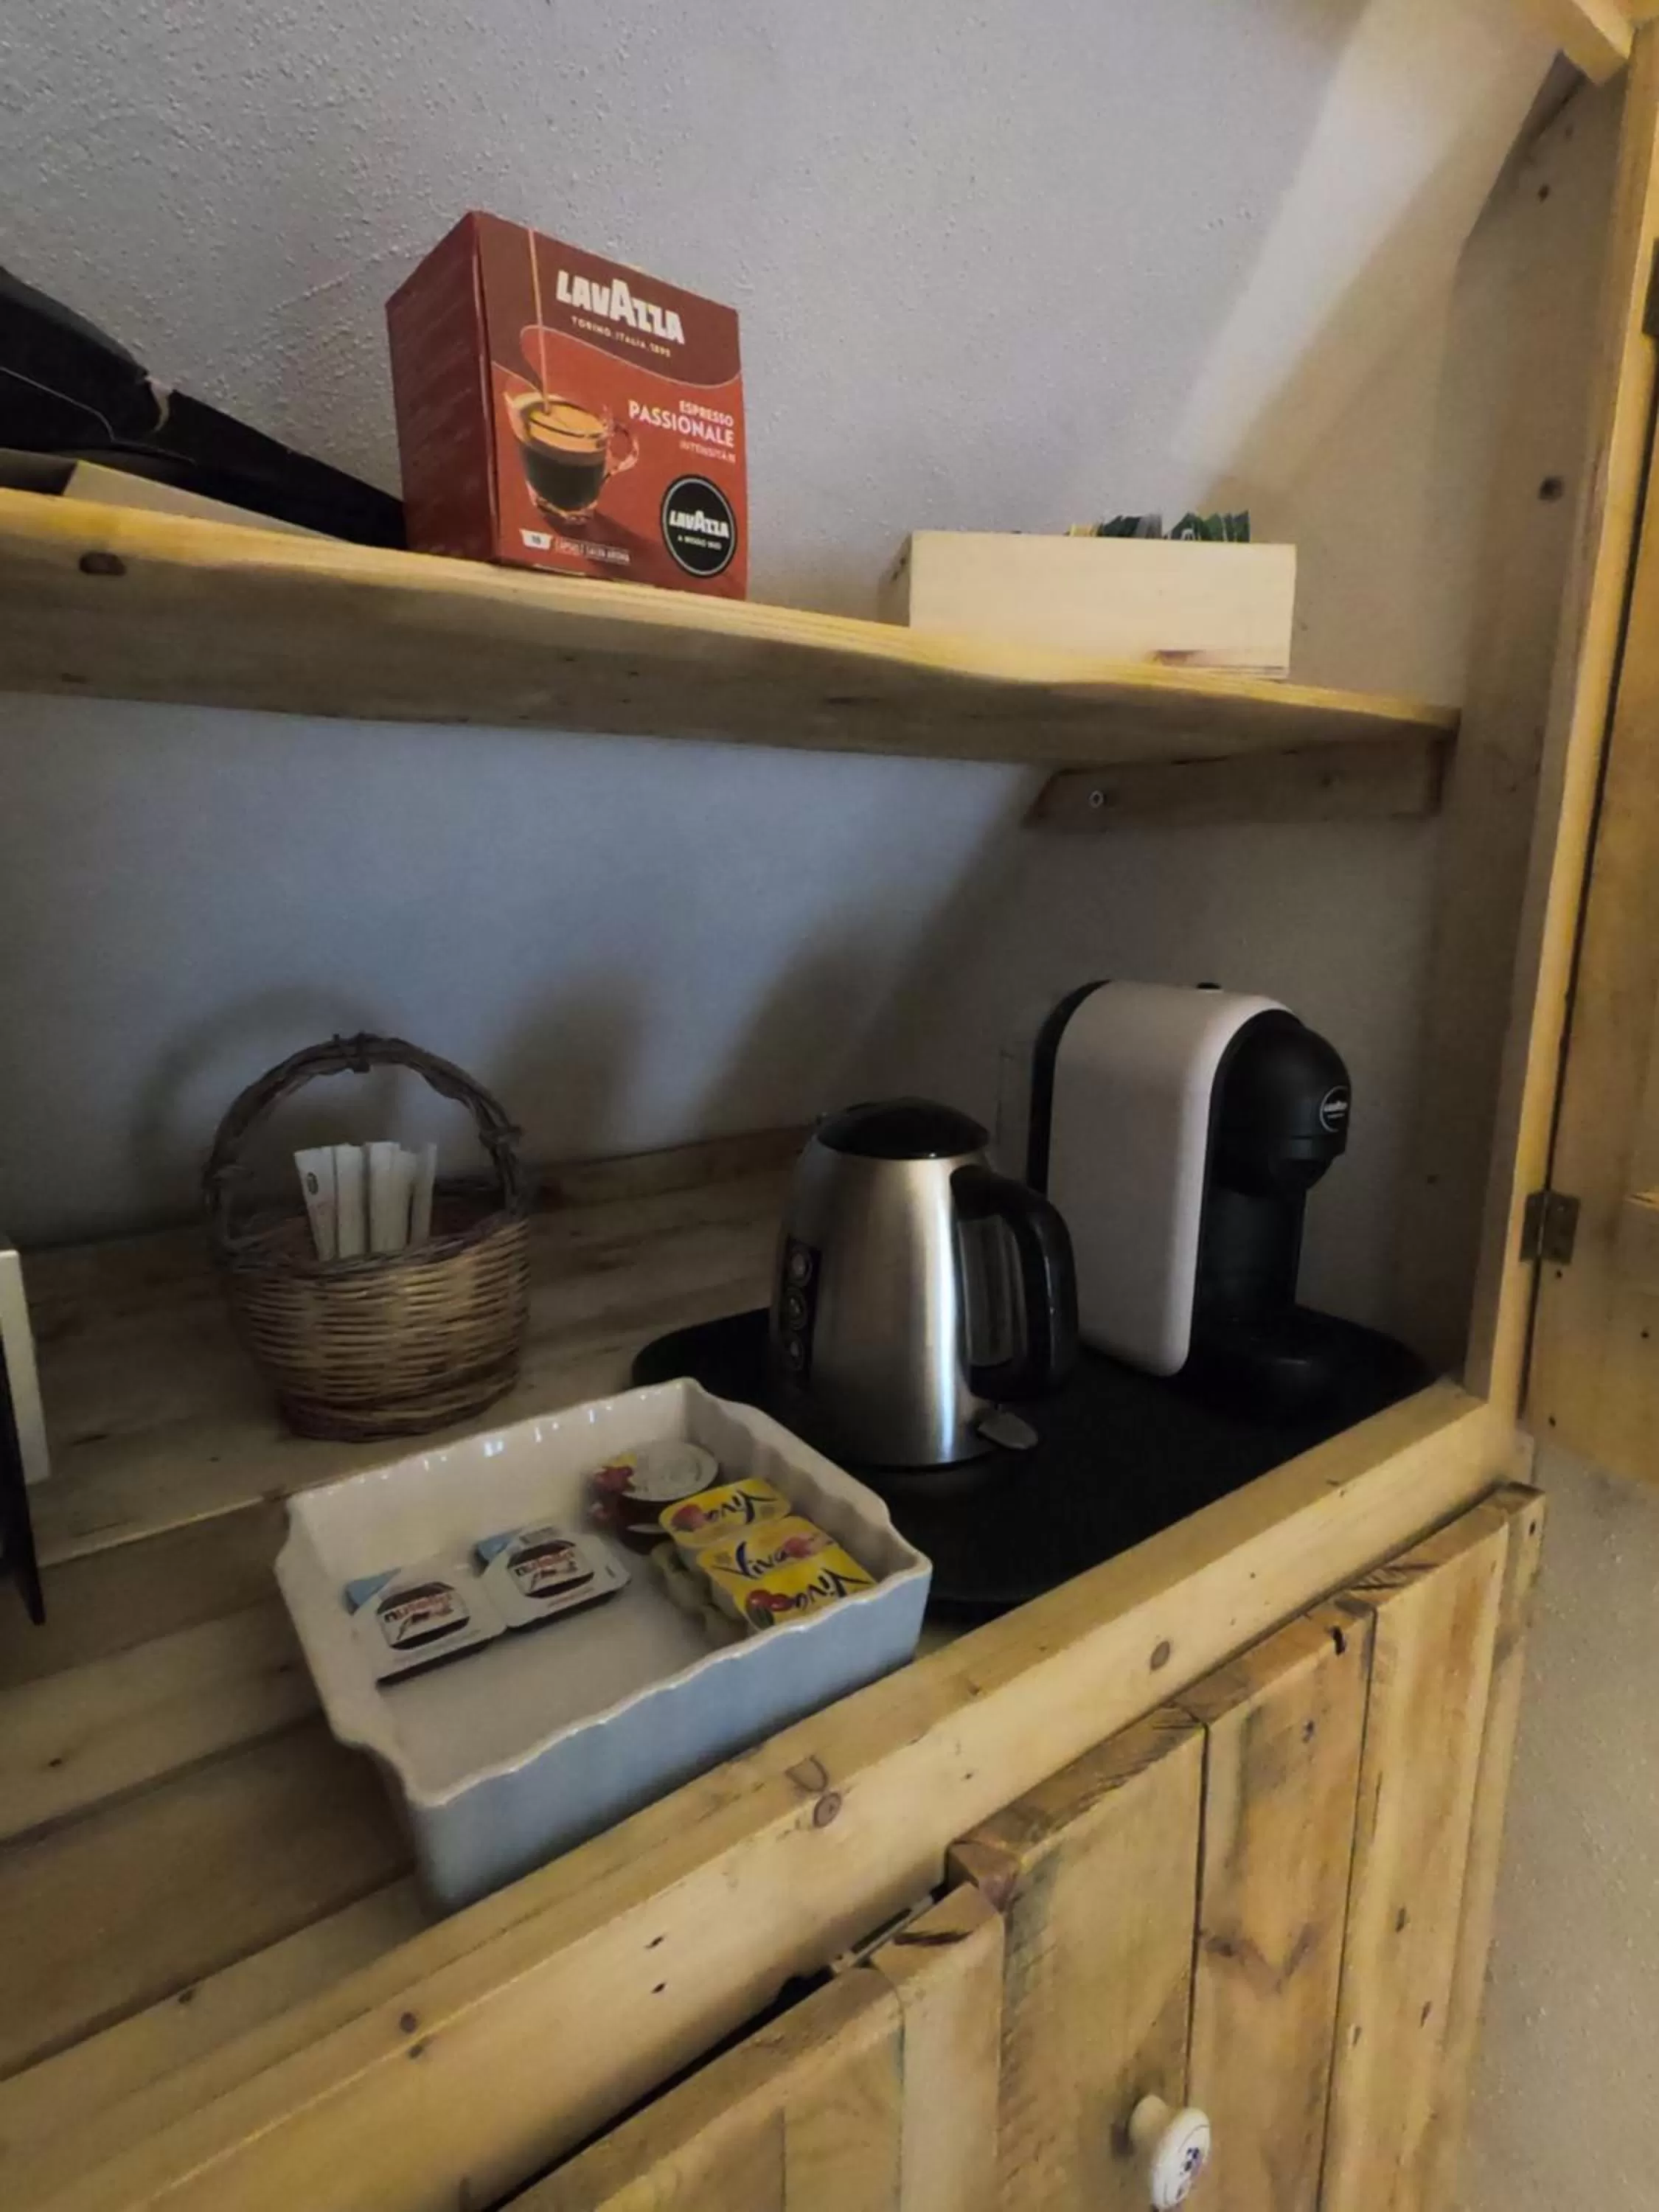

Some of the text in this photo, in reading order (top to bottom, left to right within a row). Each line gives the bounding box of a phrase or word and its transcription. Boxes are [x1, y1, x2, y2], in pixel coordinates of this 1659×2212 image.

[556, 269, 686, 345] LAVAZZA
[627, 399, 734, 448] PASSIONALE
[679, 400, 734, 427] ESPRESSO
[669, 509, 729, 539] LAVAZZA
[709, 1540, 788, 1580] Viva
[795, 1568, 872, 1610] Viva
